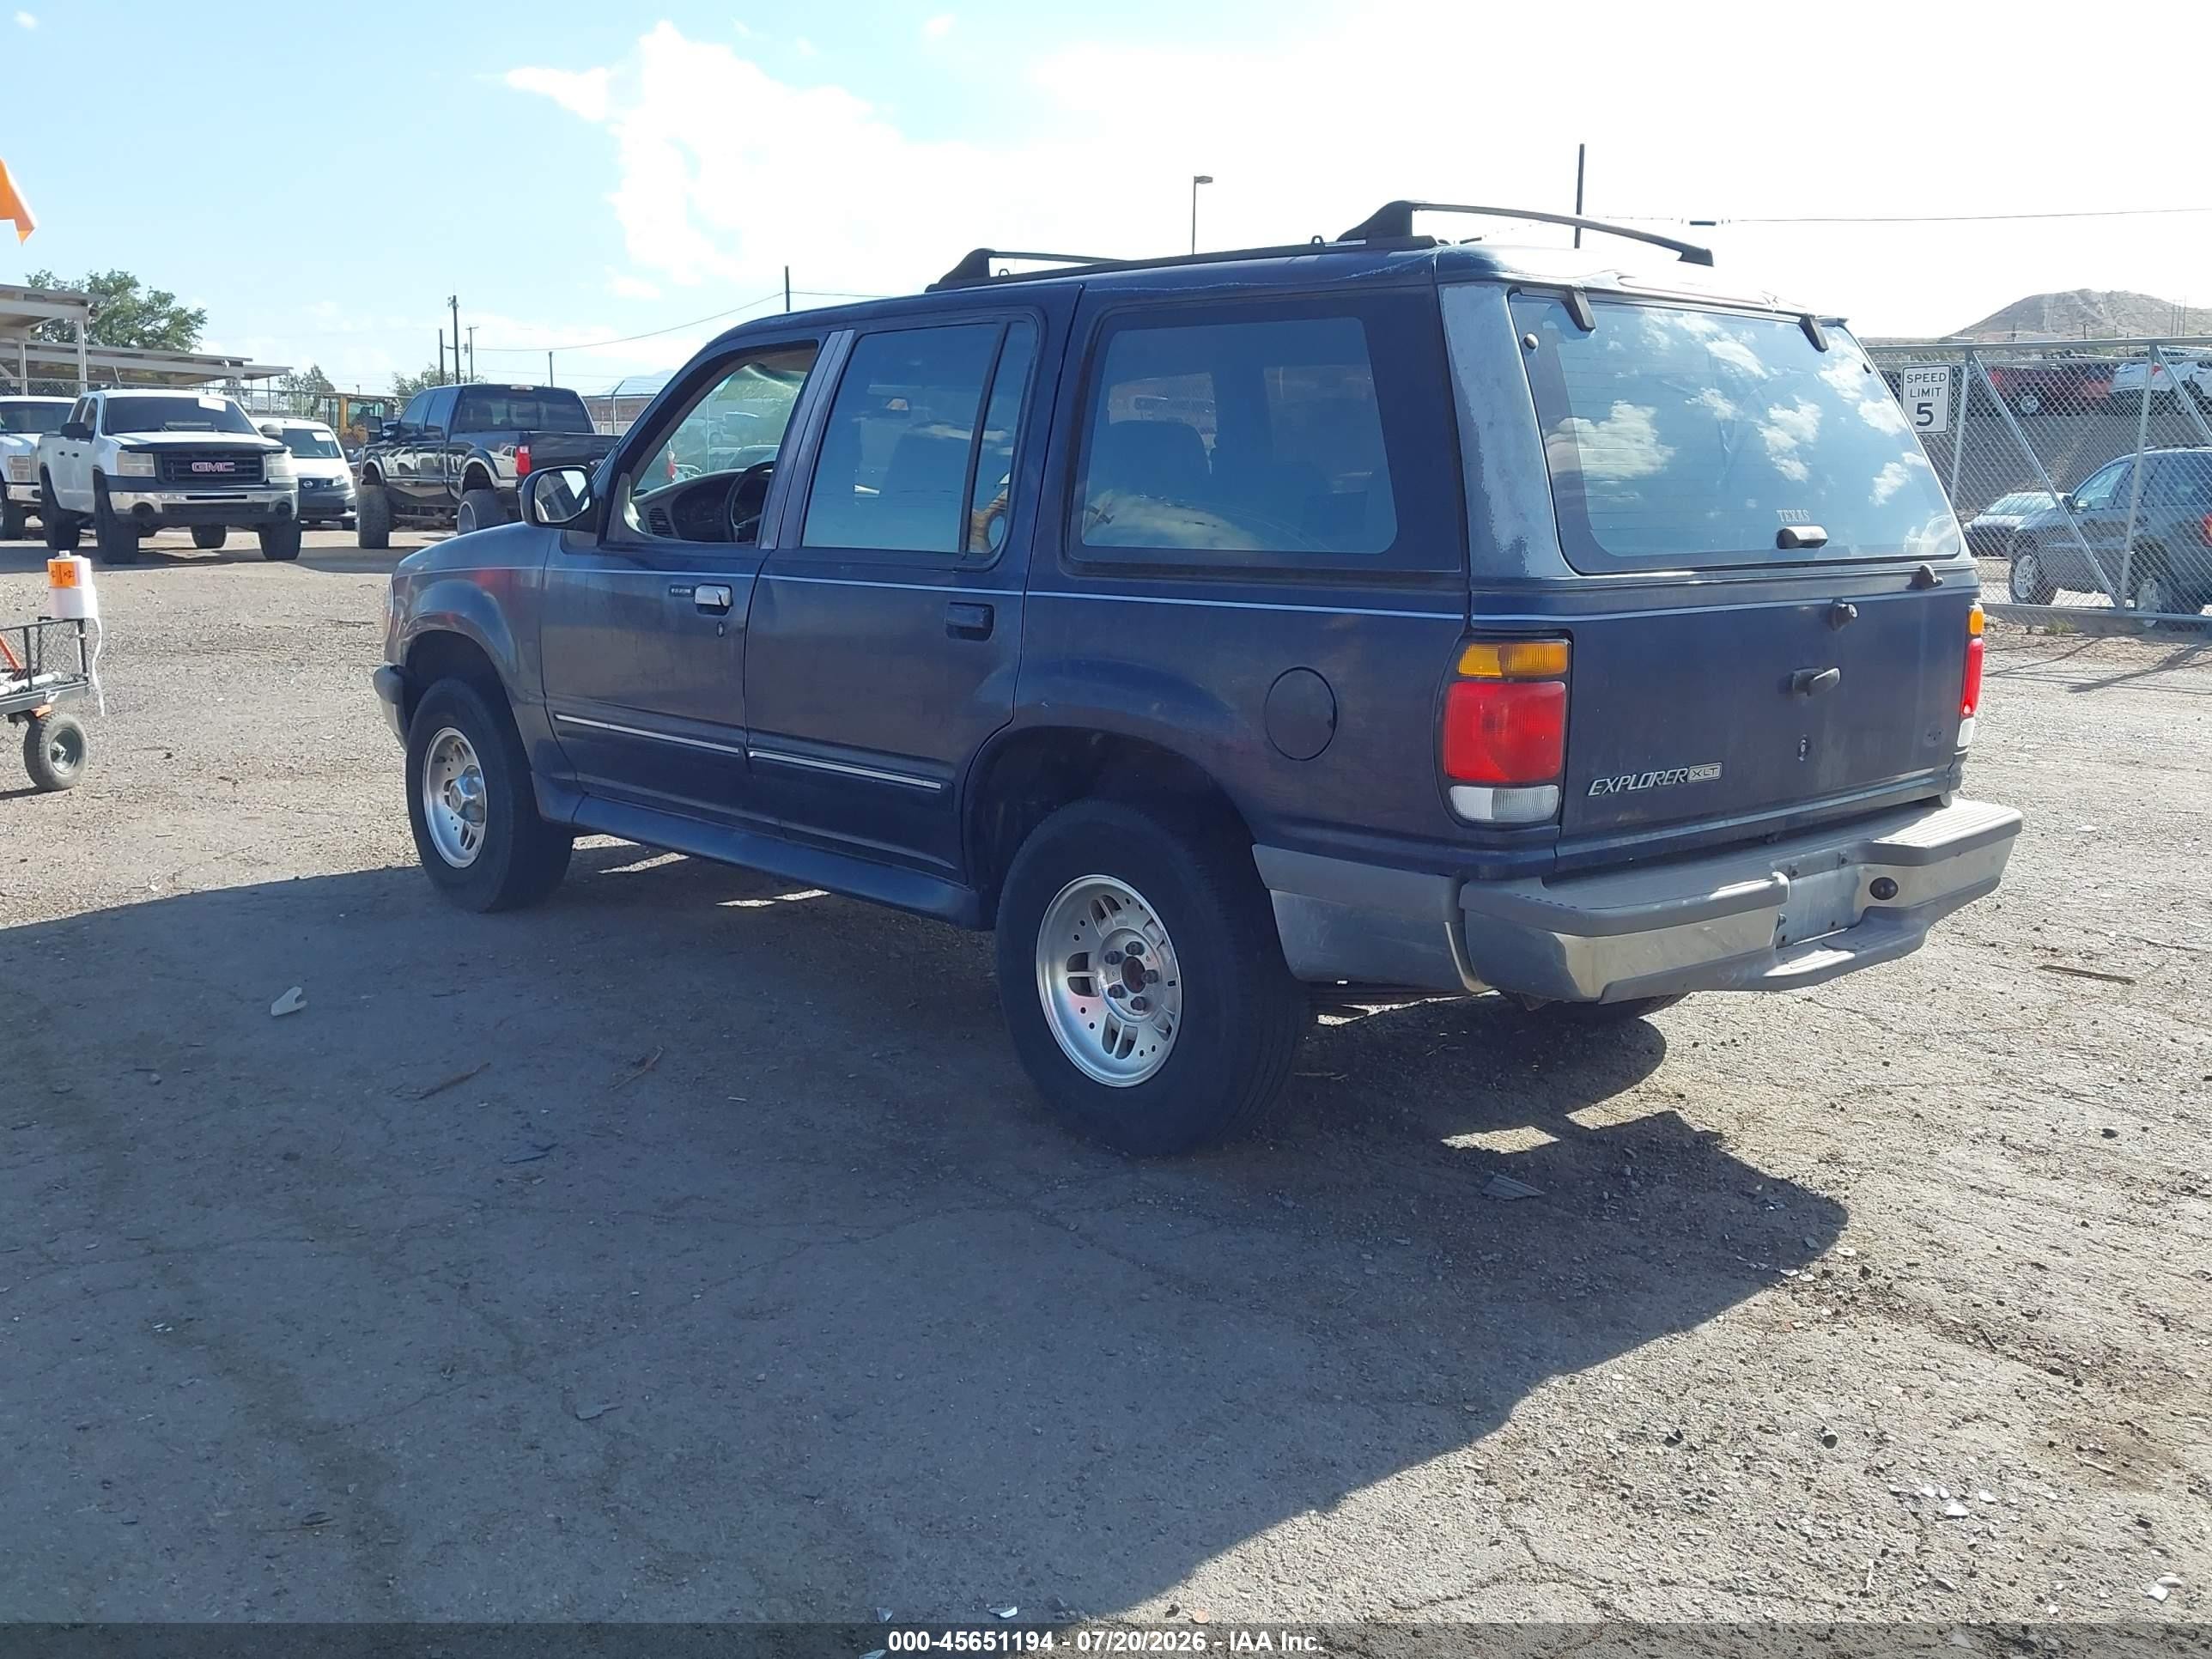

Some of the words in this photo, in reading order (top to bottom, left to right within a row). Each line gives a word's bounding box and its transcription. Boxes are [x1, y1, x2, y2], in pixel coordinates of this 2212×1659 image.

[1906, 373, 1947, 384] SPEED
[1910, 386, 1942, 398] LIMIT
[1916, 402, 1935, 427] 5
[191, 461, 236, 472] GMC
[1776, 509, 1810, 522] TEXAS
[1588, 768, 1688, 796] EXPLORER
